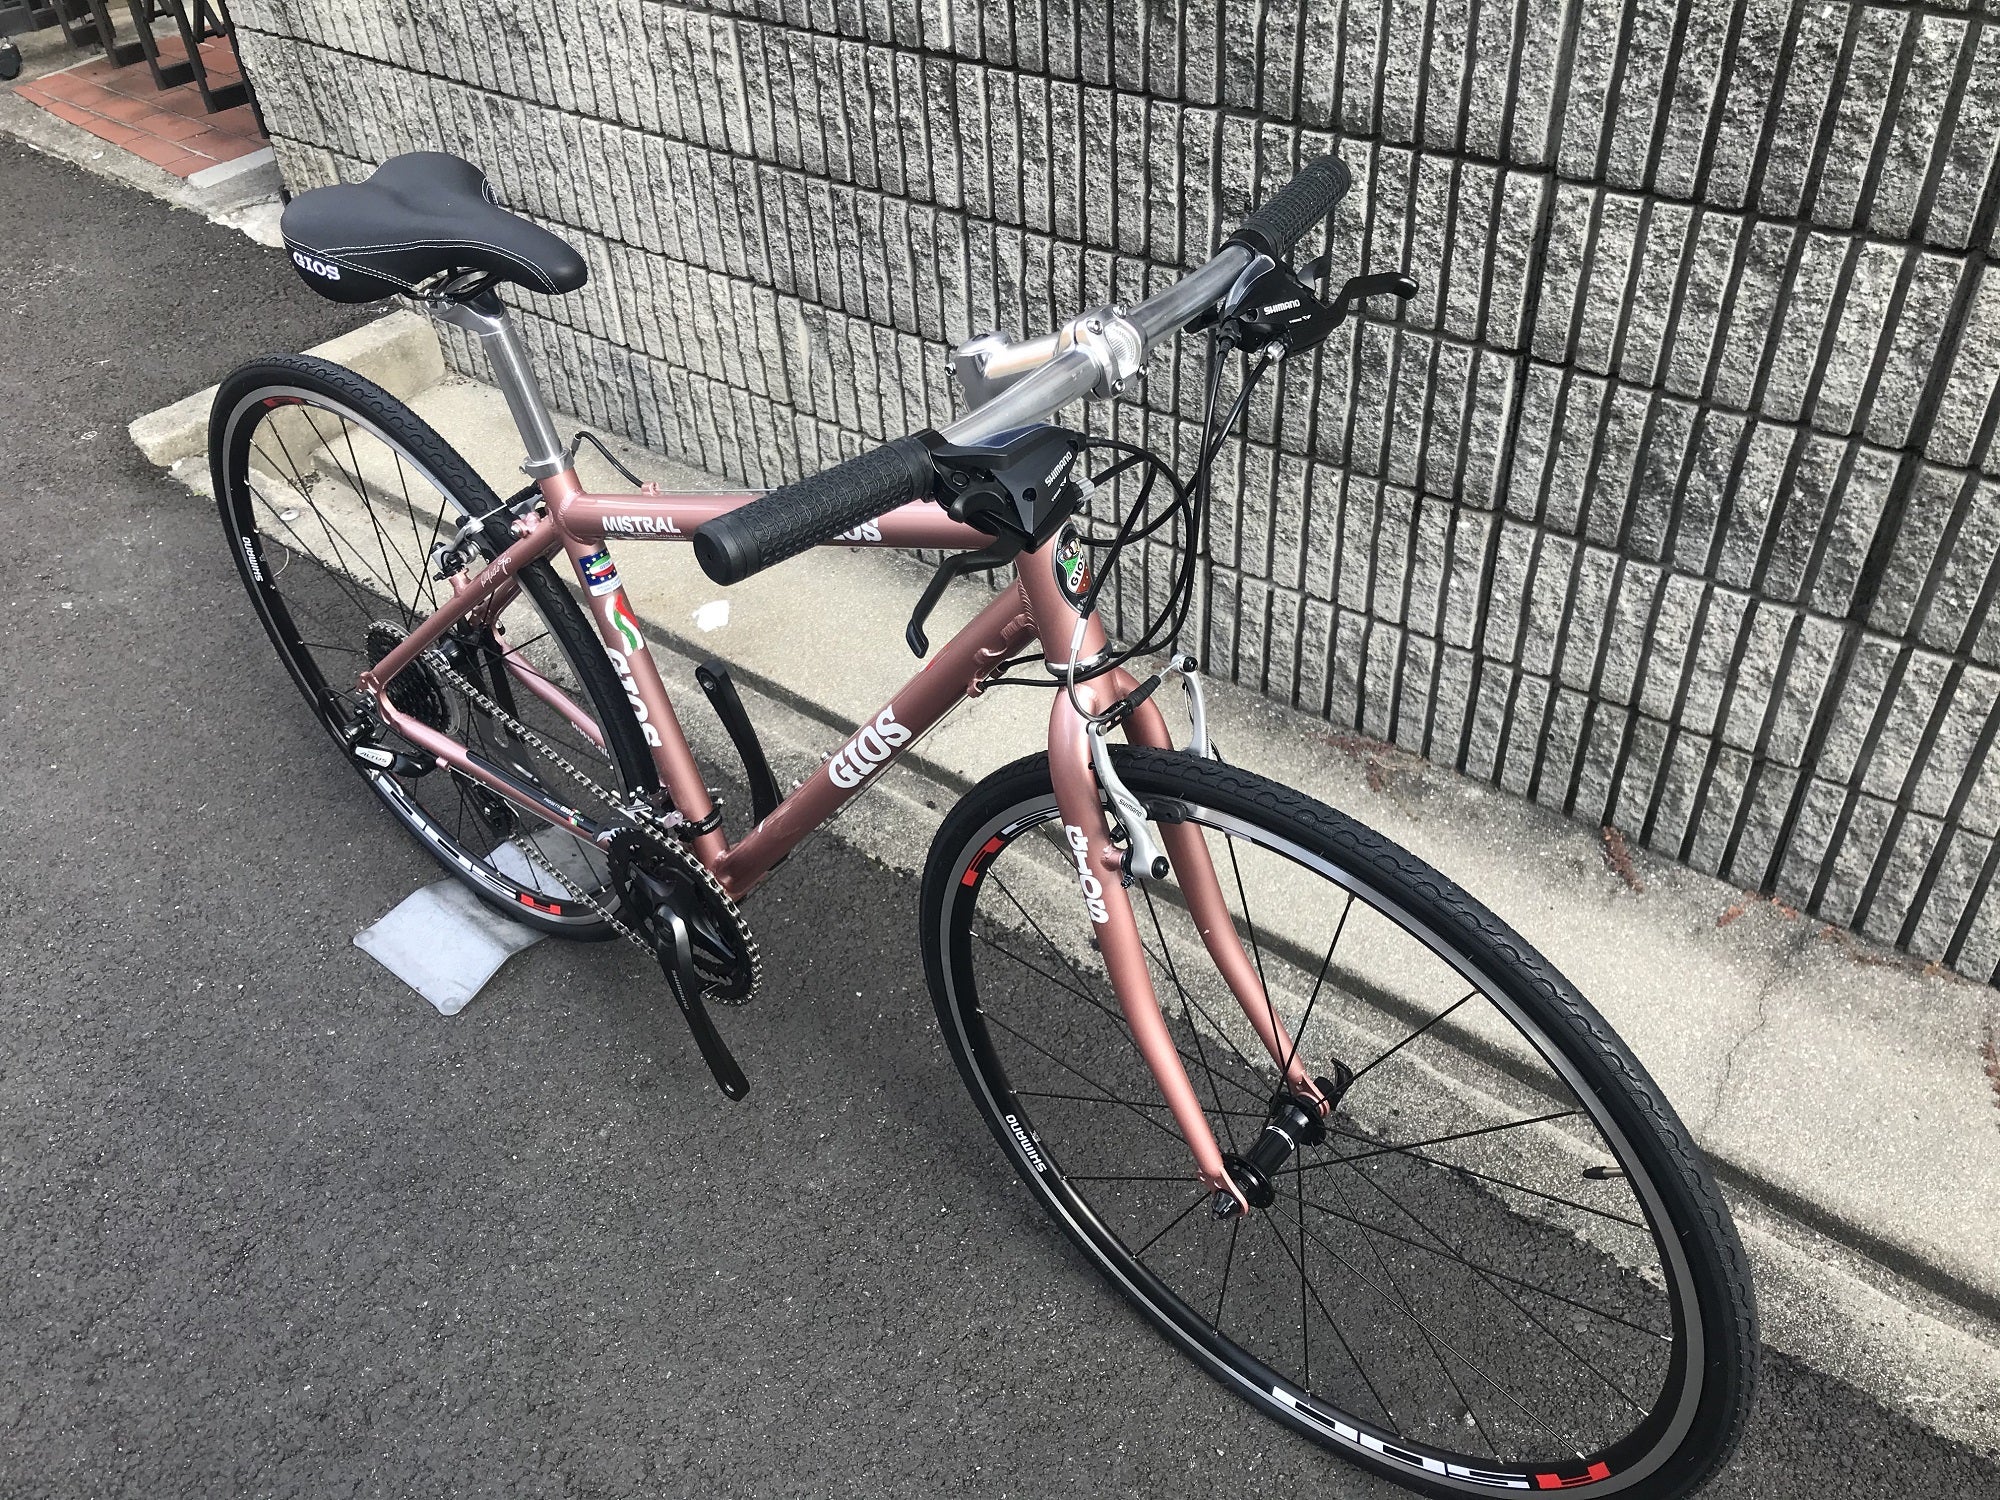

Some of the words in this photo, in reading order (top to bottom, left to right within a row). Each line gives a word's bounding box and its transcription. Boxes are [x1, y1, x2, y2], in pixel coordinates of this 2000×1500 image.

[292, 251, 341, 281] GIOS
[1263, 299, 1301, 316] SHIMANO
[1044, 451, 1073, 487] SHIMANO
[601, 515, 682, 533] MISTRAL
[242, 536, 264, 582] SHIMANO
[1070, 554, 1084, 587] GIOS
[360, 752, 387, 763] ALTUS
[828, 704, 913, 789] GIOS
[1118, 797, 1144, 818] SHIMANO
[1065, 825, 1110, 924] GIOS
[1005, 1114, 1048, 1173] SHIMANO
